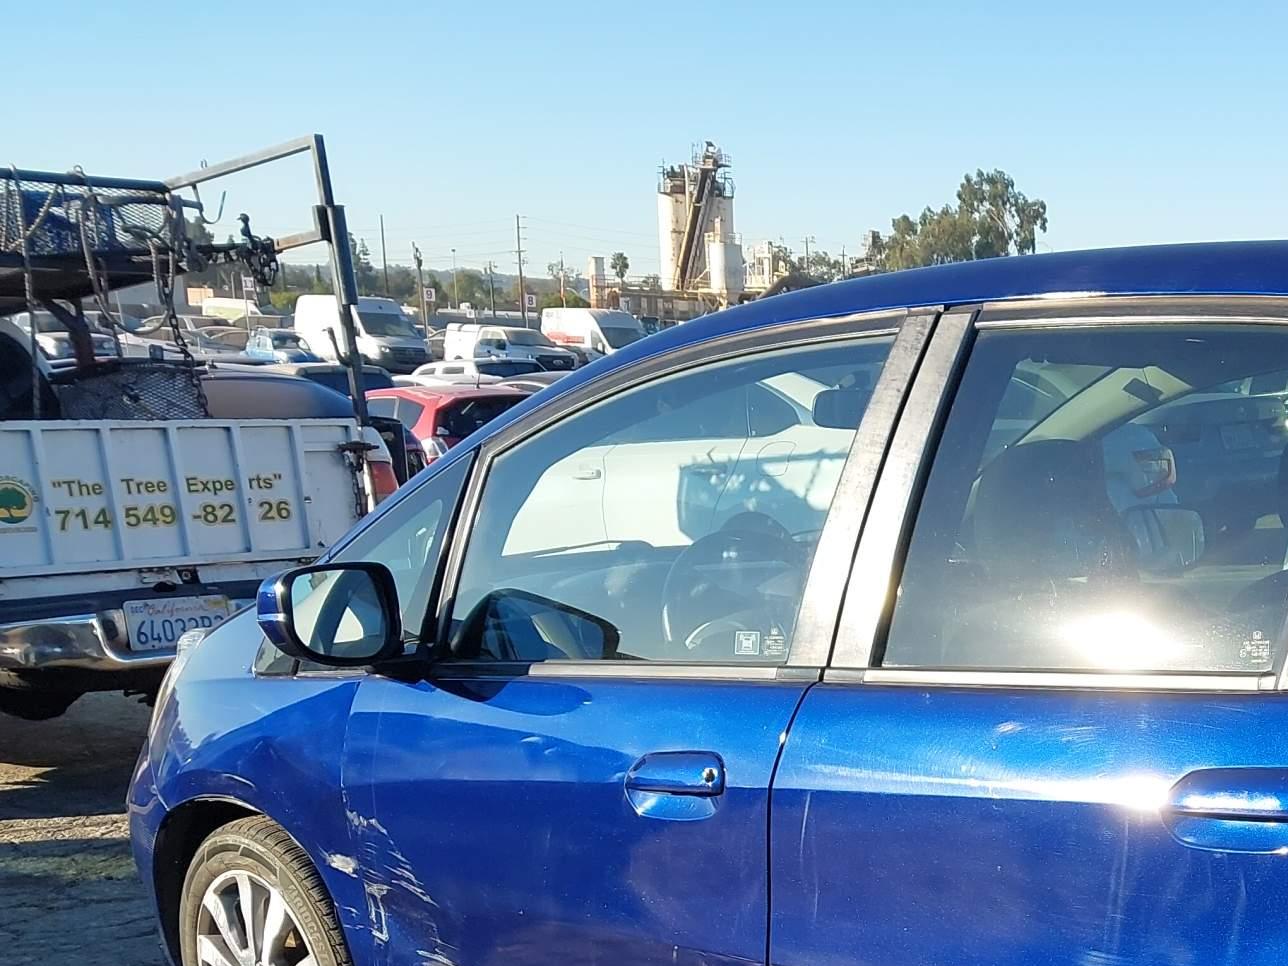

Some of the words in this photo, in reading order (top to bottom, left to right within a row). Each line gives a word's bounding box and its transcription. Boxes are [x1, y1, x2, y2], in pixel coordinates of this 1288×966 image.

[425, 289, 433, 300] 9
[527, 296, 535, 306] 8
[52, 479, 104, 497] "The
[120, 478, 168, 495] Tree
[55, 506, 112, 531] 714
[124, 504, 177, 528] 549
